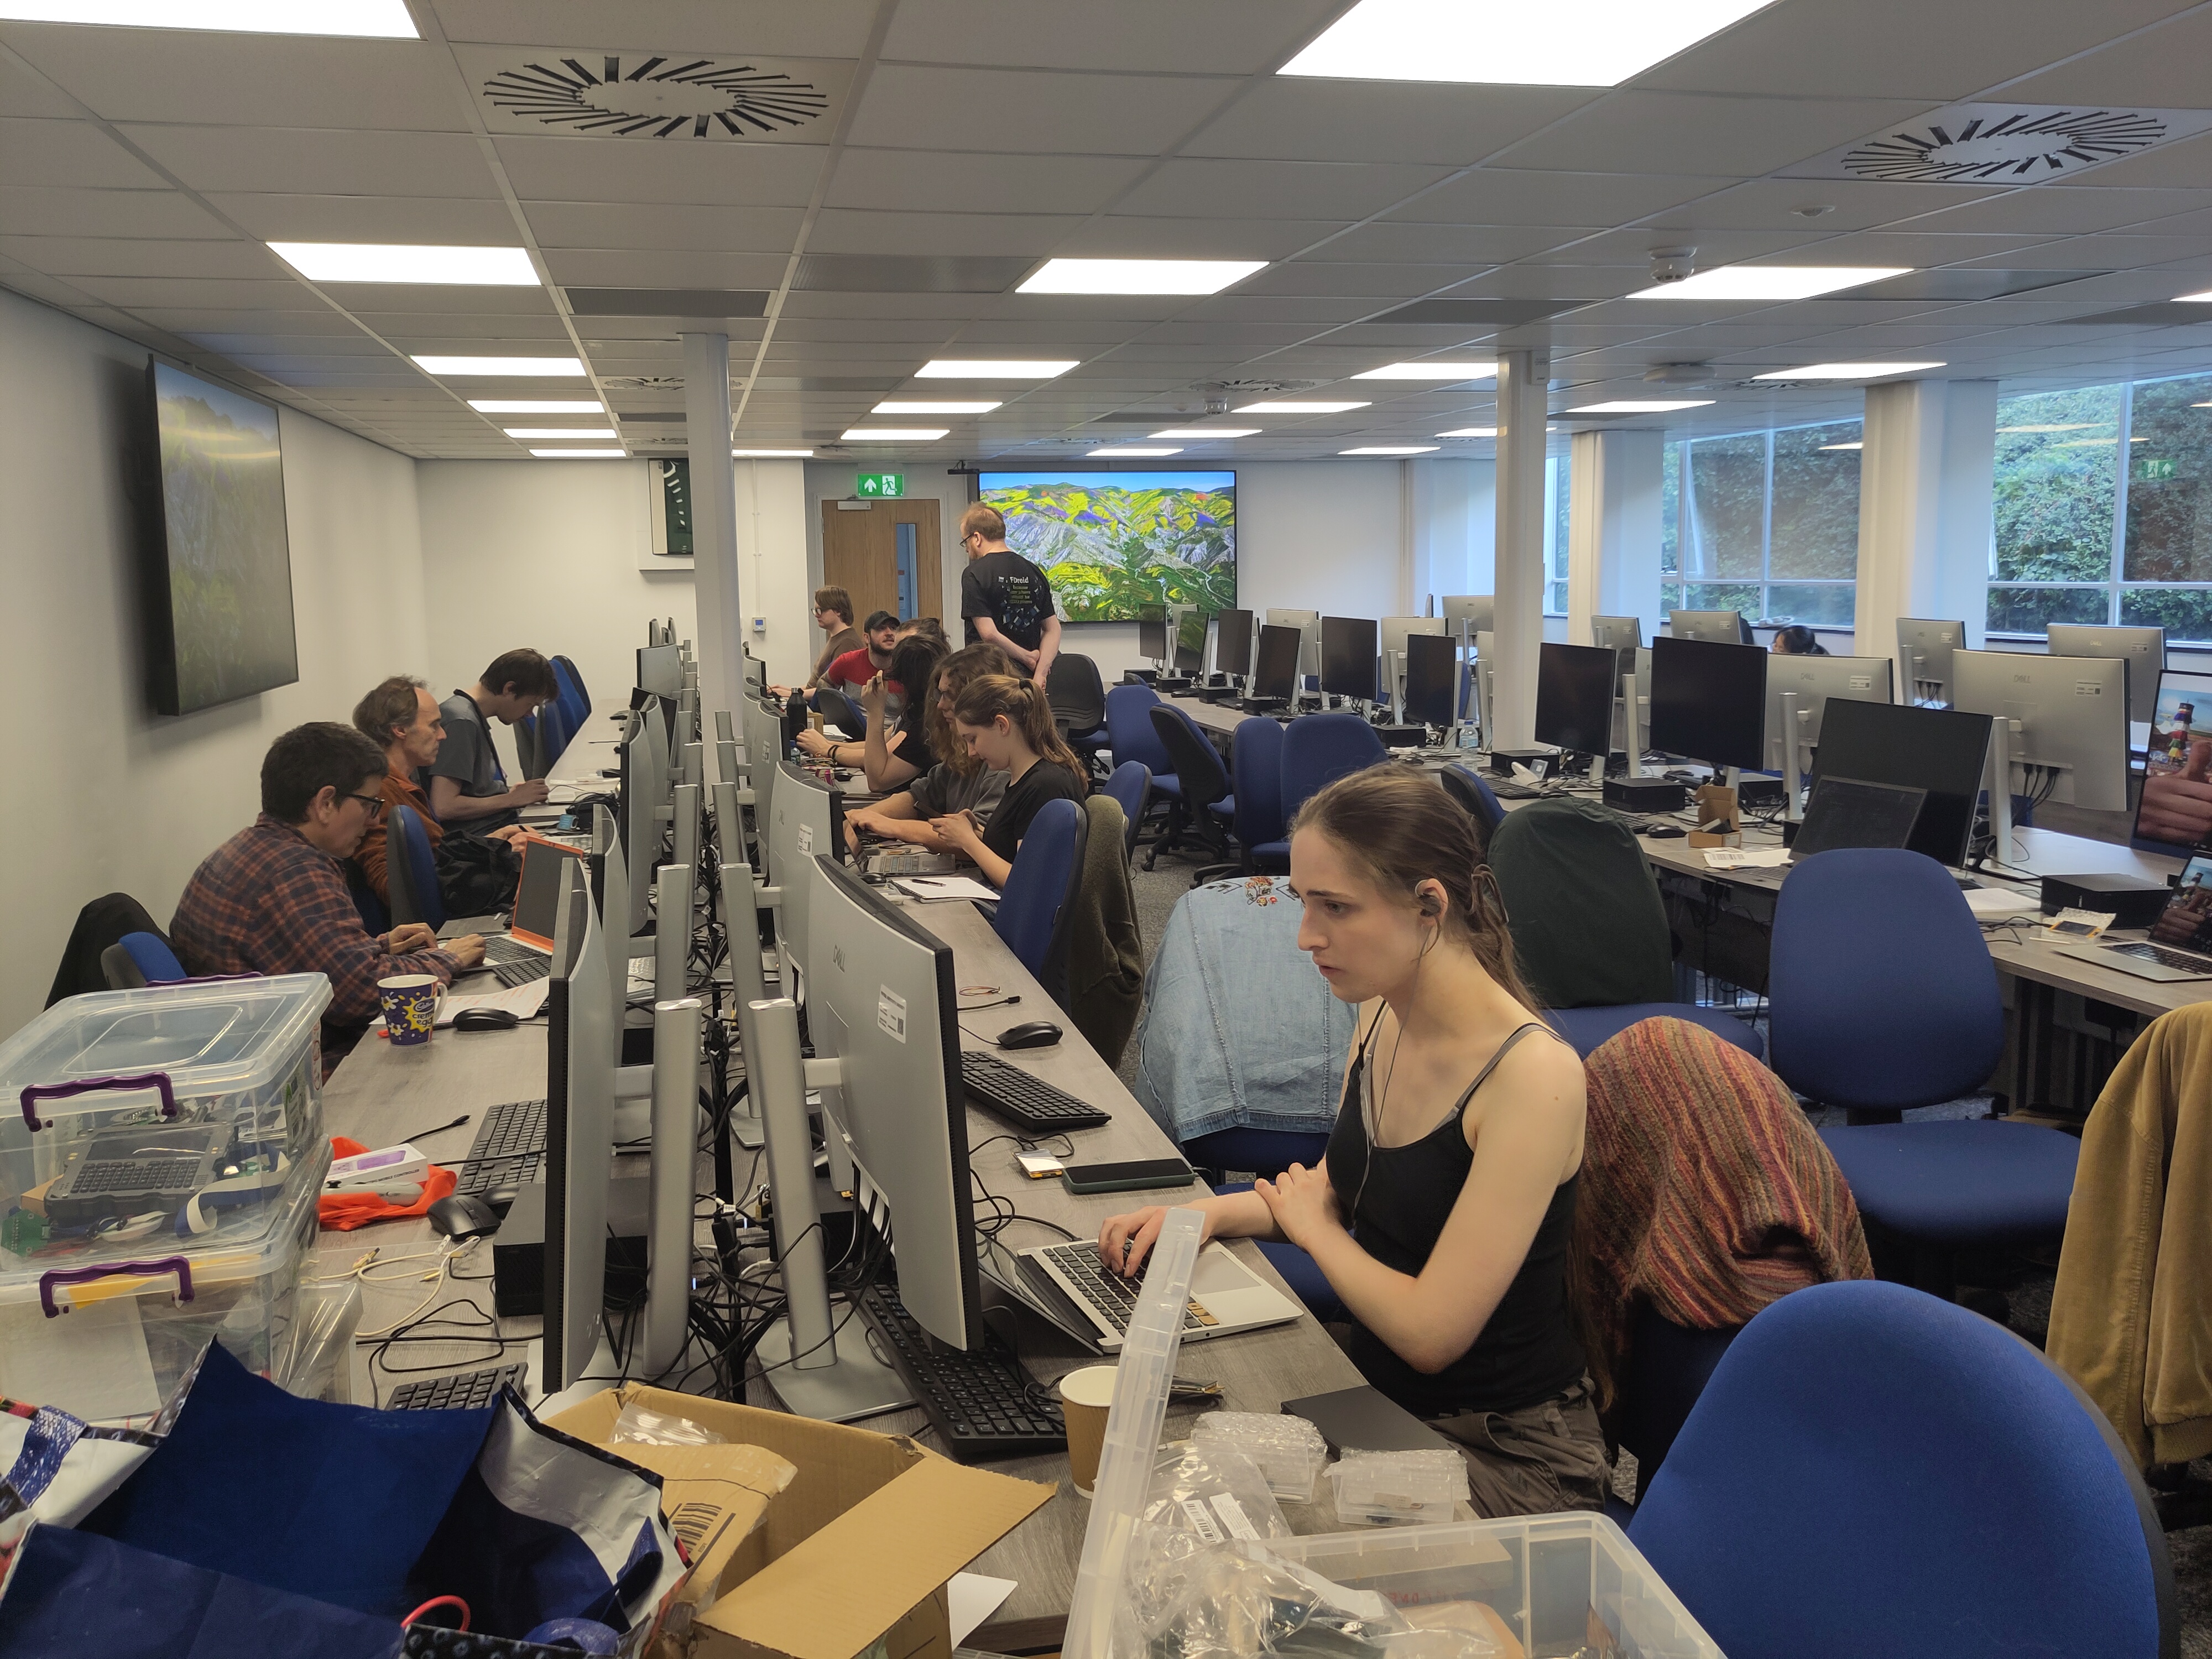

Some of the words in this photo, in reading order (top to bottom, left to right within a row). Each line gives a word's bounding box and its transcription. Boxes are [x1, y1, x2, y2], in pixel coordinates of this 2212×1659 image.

[2013, 675, 2031, 684] DELL
[833, 944, 845, 973] DELL
[394, 1169, 419, 1177] CONTROLLER
